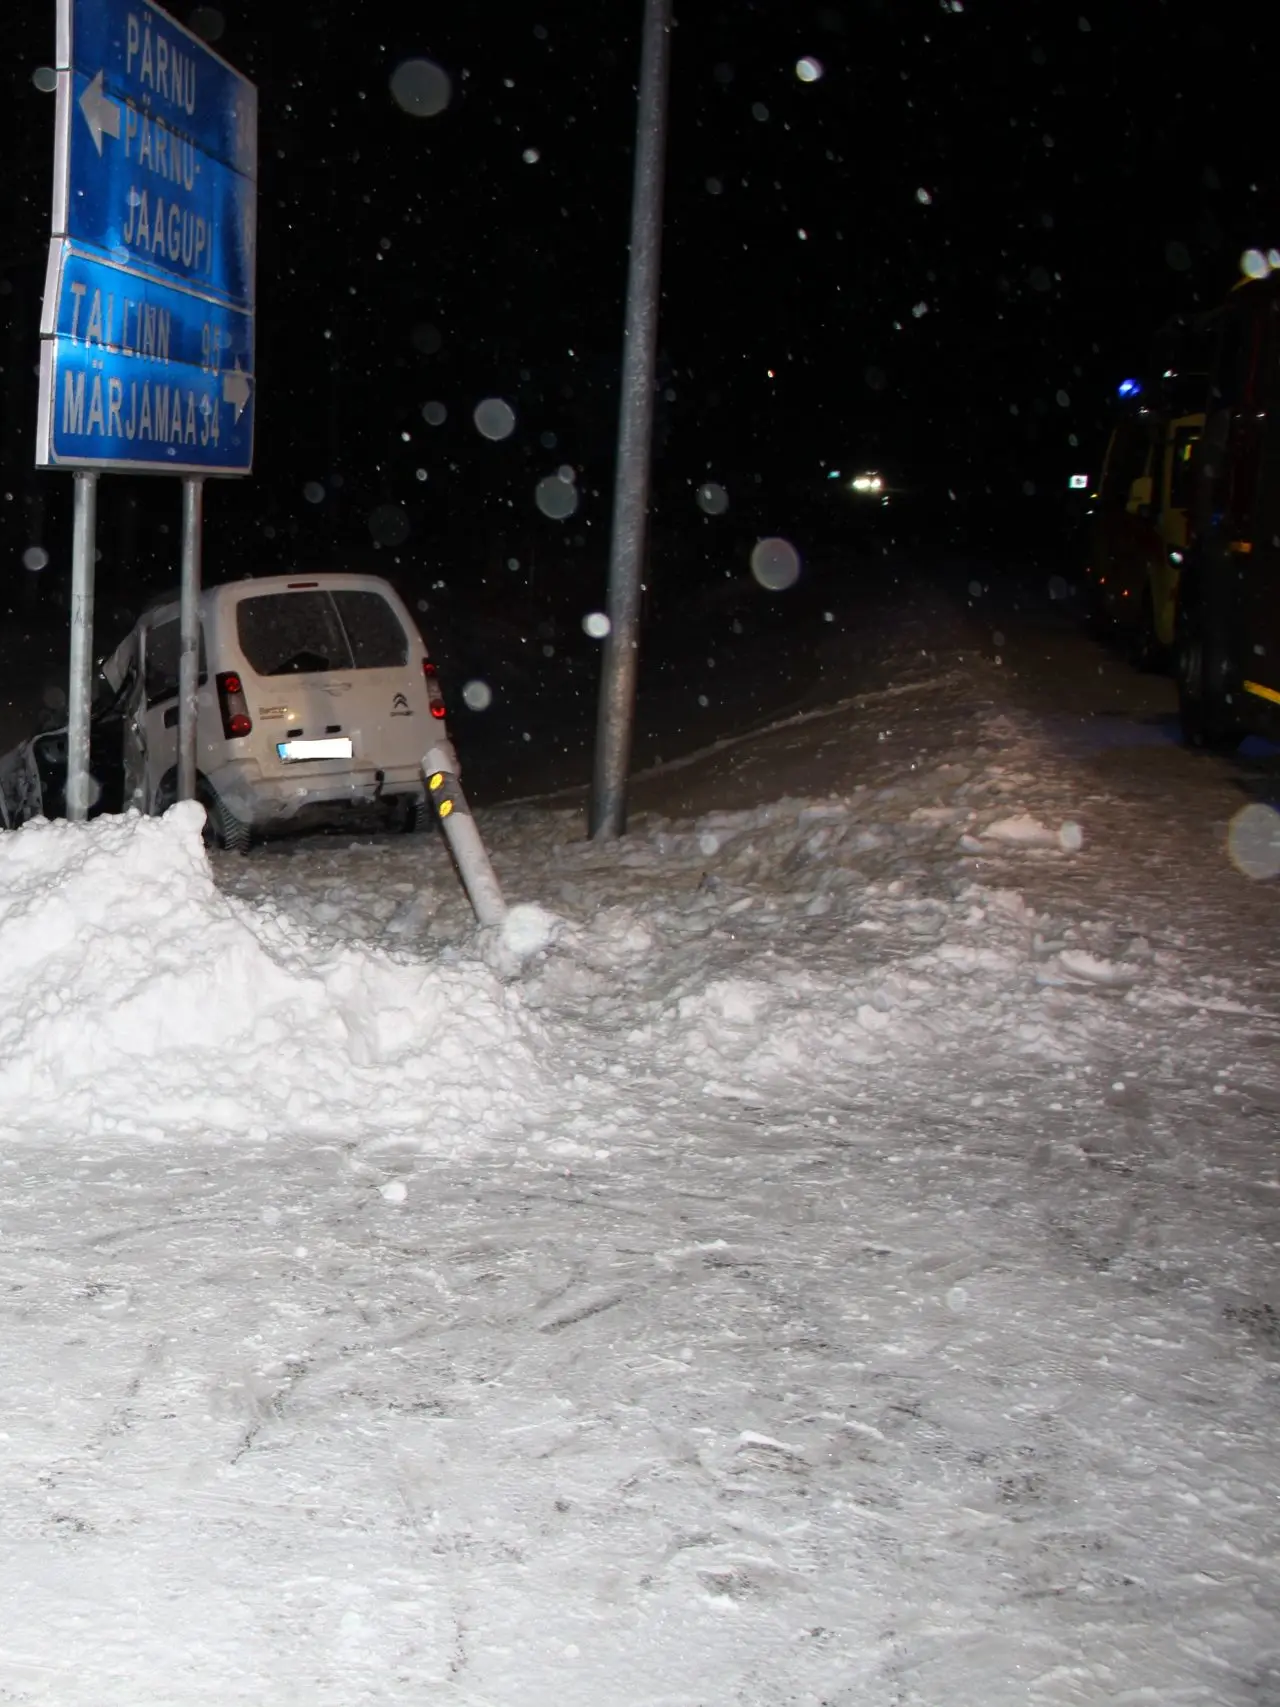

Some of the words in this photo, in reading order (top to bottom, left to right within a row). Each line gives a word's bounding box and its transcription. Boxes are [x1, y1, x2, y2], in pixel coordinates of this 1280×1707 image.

[126, 11, 196, 115] PÄRNU
[124, 92, 201, 191] PÄRNU-
[123, 185, 213, 275] JAAGUPI
[70, 280, 170, 365] TALLINN
[62, 359, 197, 445] MÄRJAMAA
[200, 393, 221, 448] 34
